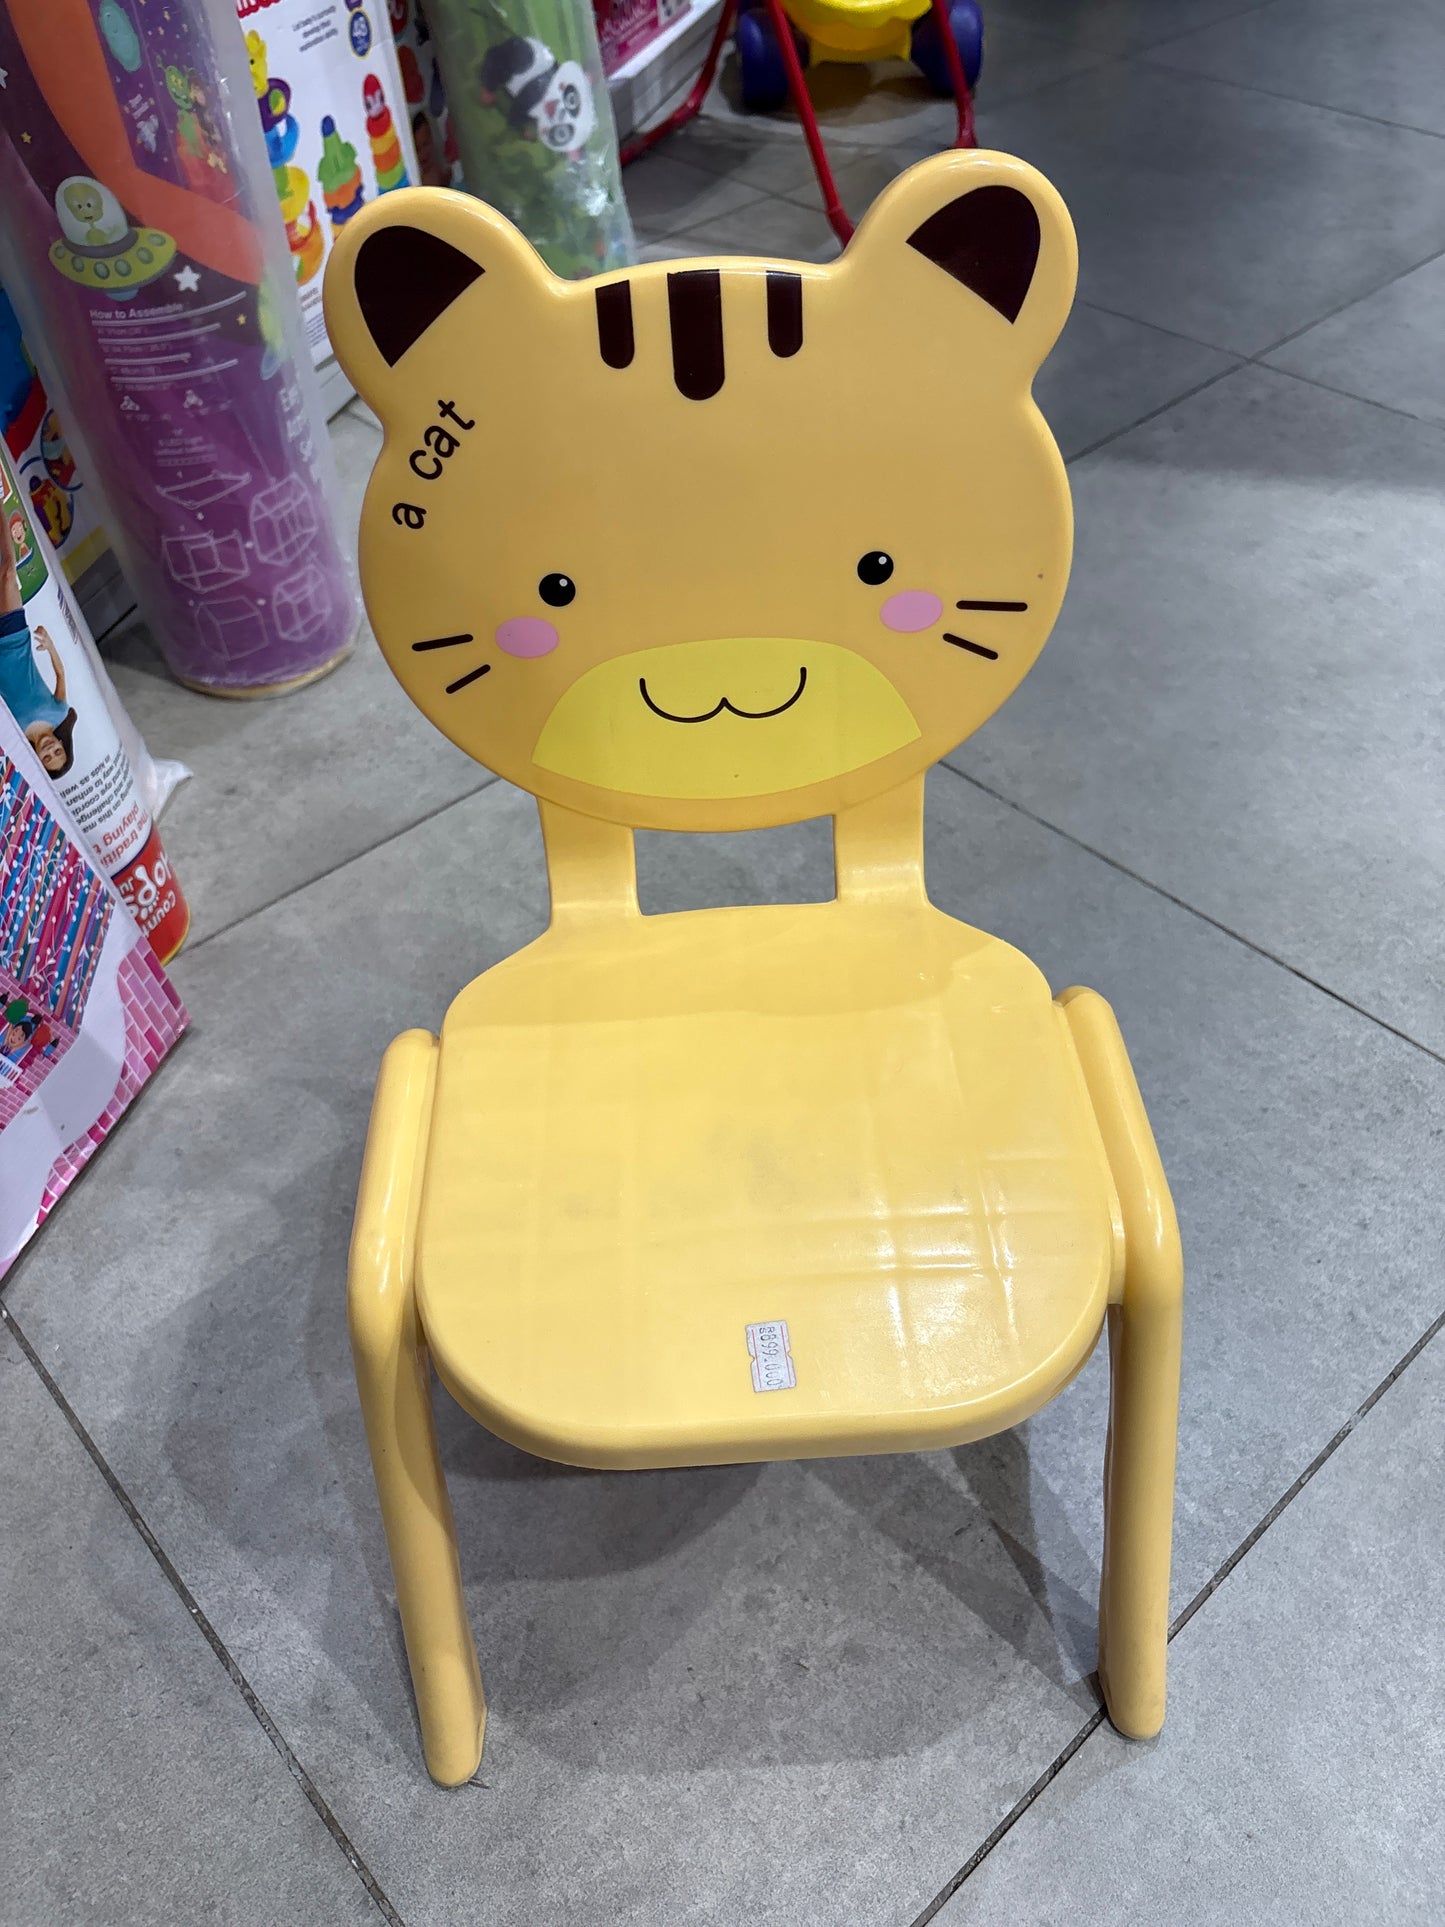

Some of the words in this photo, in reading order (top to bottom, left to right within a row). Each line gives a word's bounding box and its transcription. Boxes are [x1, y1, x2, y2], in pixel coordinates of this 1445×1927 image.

[89, 309, 113, 320] How
[115, 310, 127, 319] to
[409, 399, 475, 480] cat
[392, 502, 427, 529] a
[79, 775, 90, 785] as
[94, 778, 103, 787] to
[98, 810, 113, 823] this
[102, 800, 139, 847] playing
